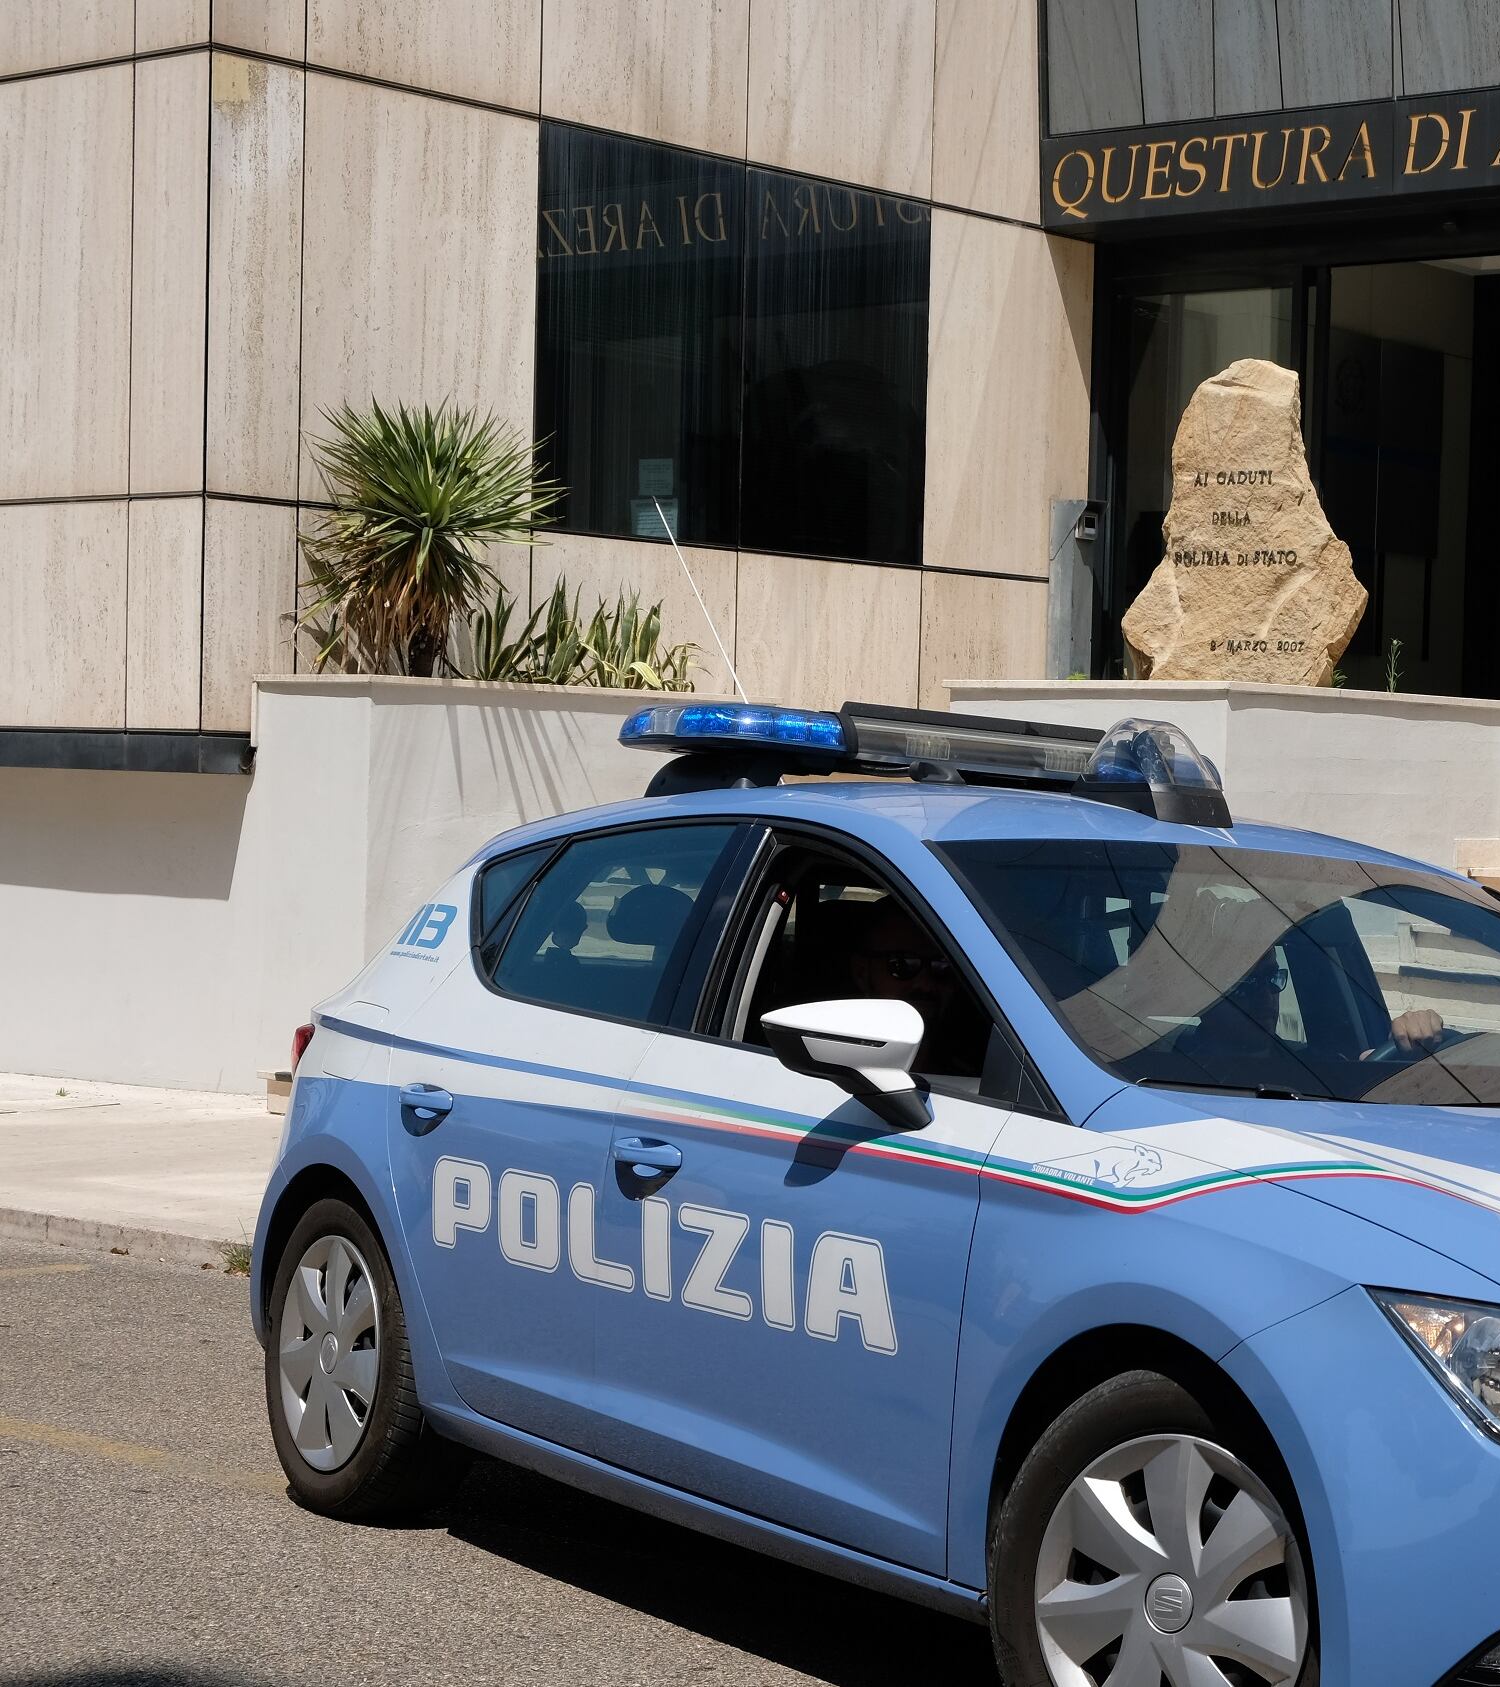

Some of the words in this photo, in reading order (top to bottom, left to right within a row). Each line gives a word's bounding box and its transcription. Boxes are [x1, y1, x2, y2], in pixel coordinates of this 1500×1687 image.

[1051, 120, 1376, 219] QUESTURA
[1402, 109, 1478, 175] DI
[1194, 472, 1209, 487] AI
[1216, 470, 1273, 485] CADUTI
[1212, 510, 1251, 527] DELLA
[1173, 550, 1231, 568] POLIZIA
[1236, 554, 1249, 566] DI
[1253, 550, 1298, 568] STATO
[1226, 640, 1268, 655] MARZO
[396, 903, 458, 950] 113
[1031, 1164, 1062, 1178] SQUADRA
[1064, 1172, 1096, 1186] VOLANTE
[431, 1155, 898, 1356] POLIZIA
